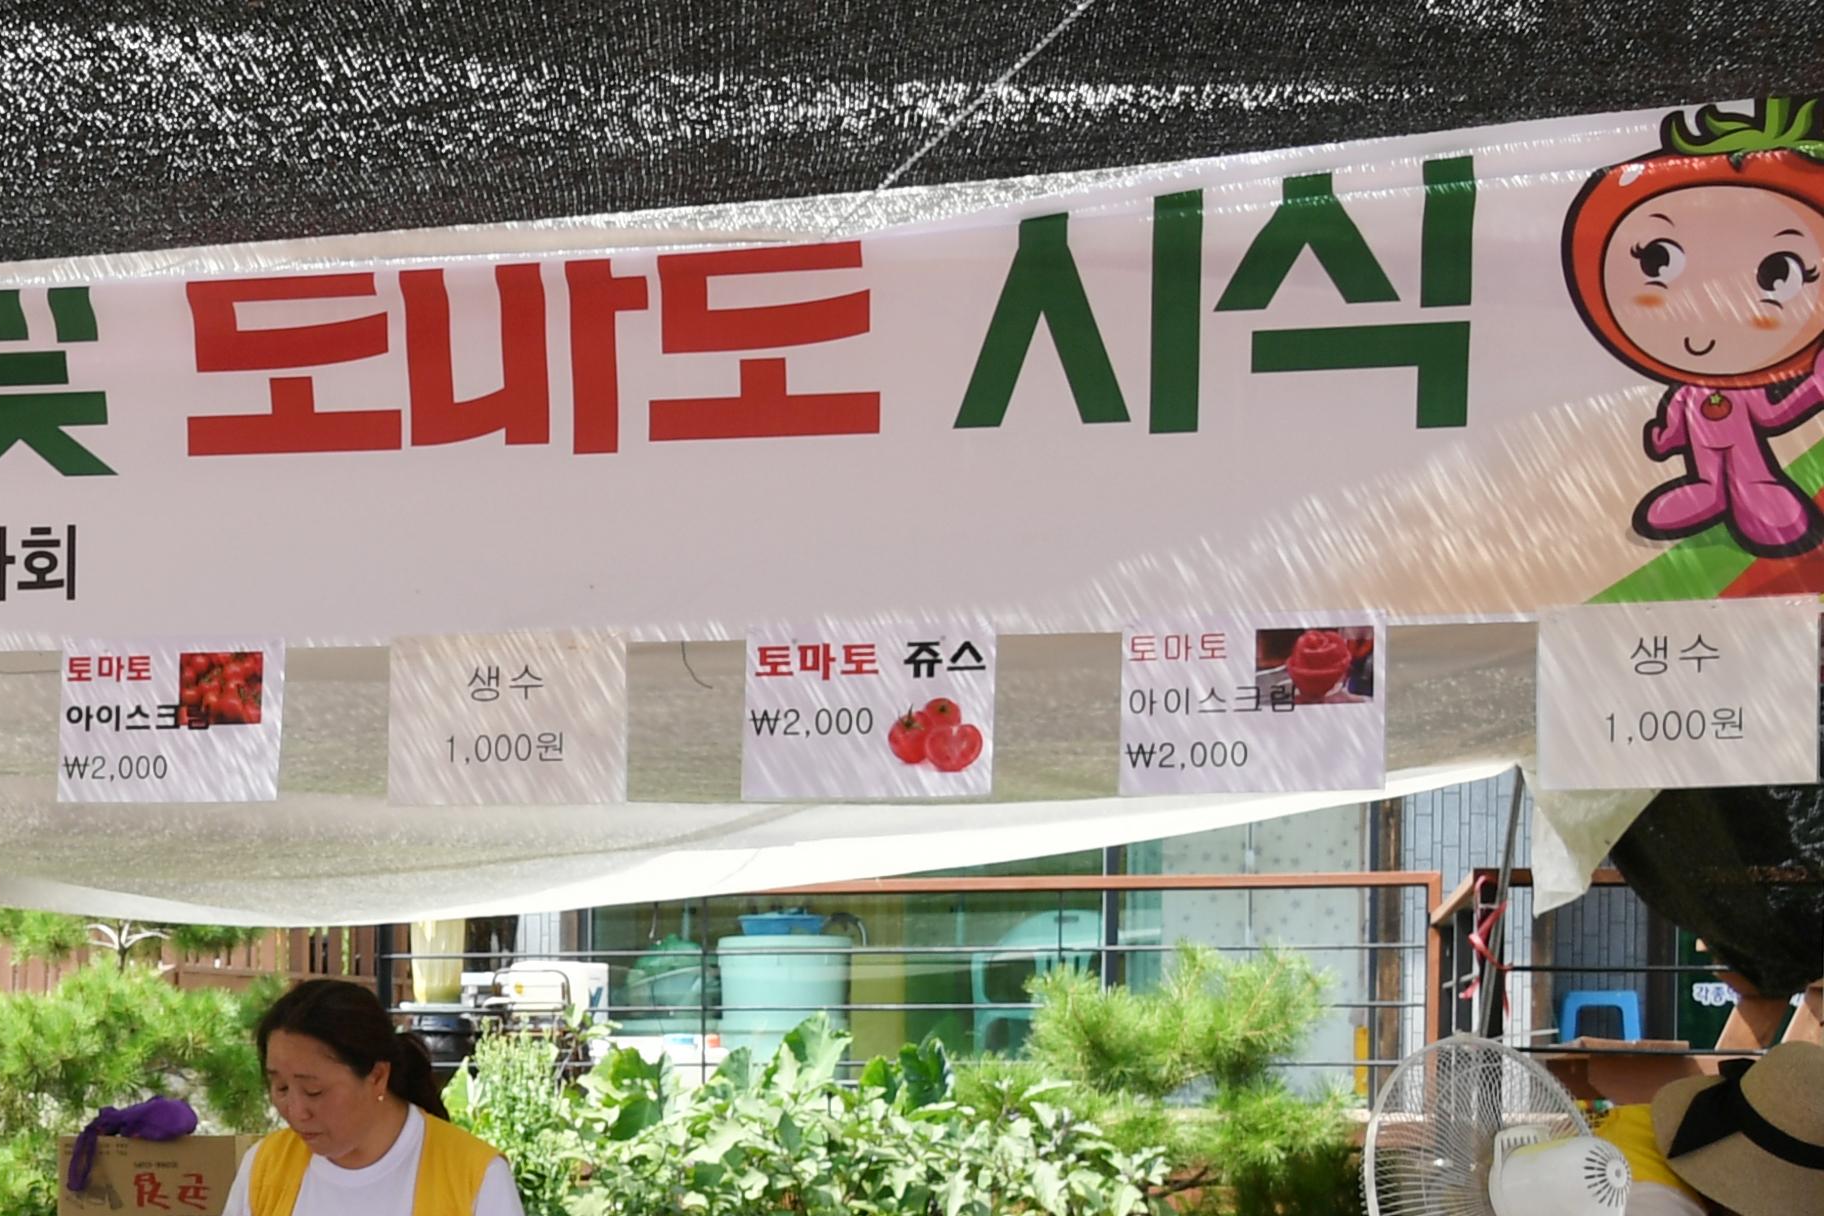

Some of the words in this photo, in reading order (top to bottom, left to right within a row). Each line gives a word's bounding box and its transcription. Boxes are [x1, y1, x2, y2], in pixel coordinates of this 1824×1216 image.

[953, 155, 1475, 434] 시식
[754, 642, 879, 681] 토마토
[903, 640, 986, 678] 쥬스
[1129, 632, 1227, 662] 토마토
[1630, 633, 1720, 676] 생수
[67, 655, 152, 682] 토마토
[467, 664, 544, 702] 생수
[1128, 685, 1297, 717] 아이스크림
[749, 706, 873, 738] ₩2,000
[1606, 706, 1744, 744] 1,000원
[446, 731, 564, 765] 1,000원
[1125, 740, 1248, 770] ₩2,000
[62, 754, 168, 781] ₩2,000
